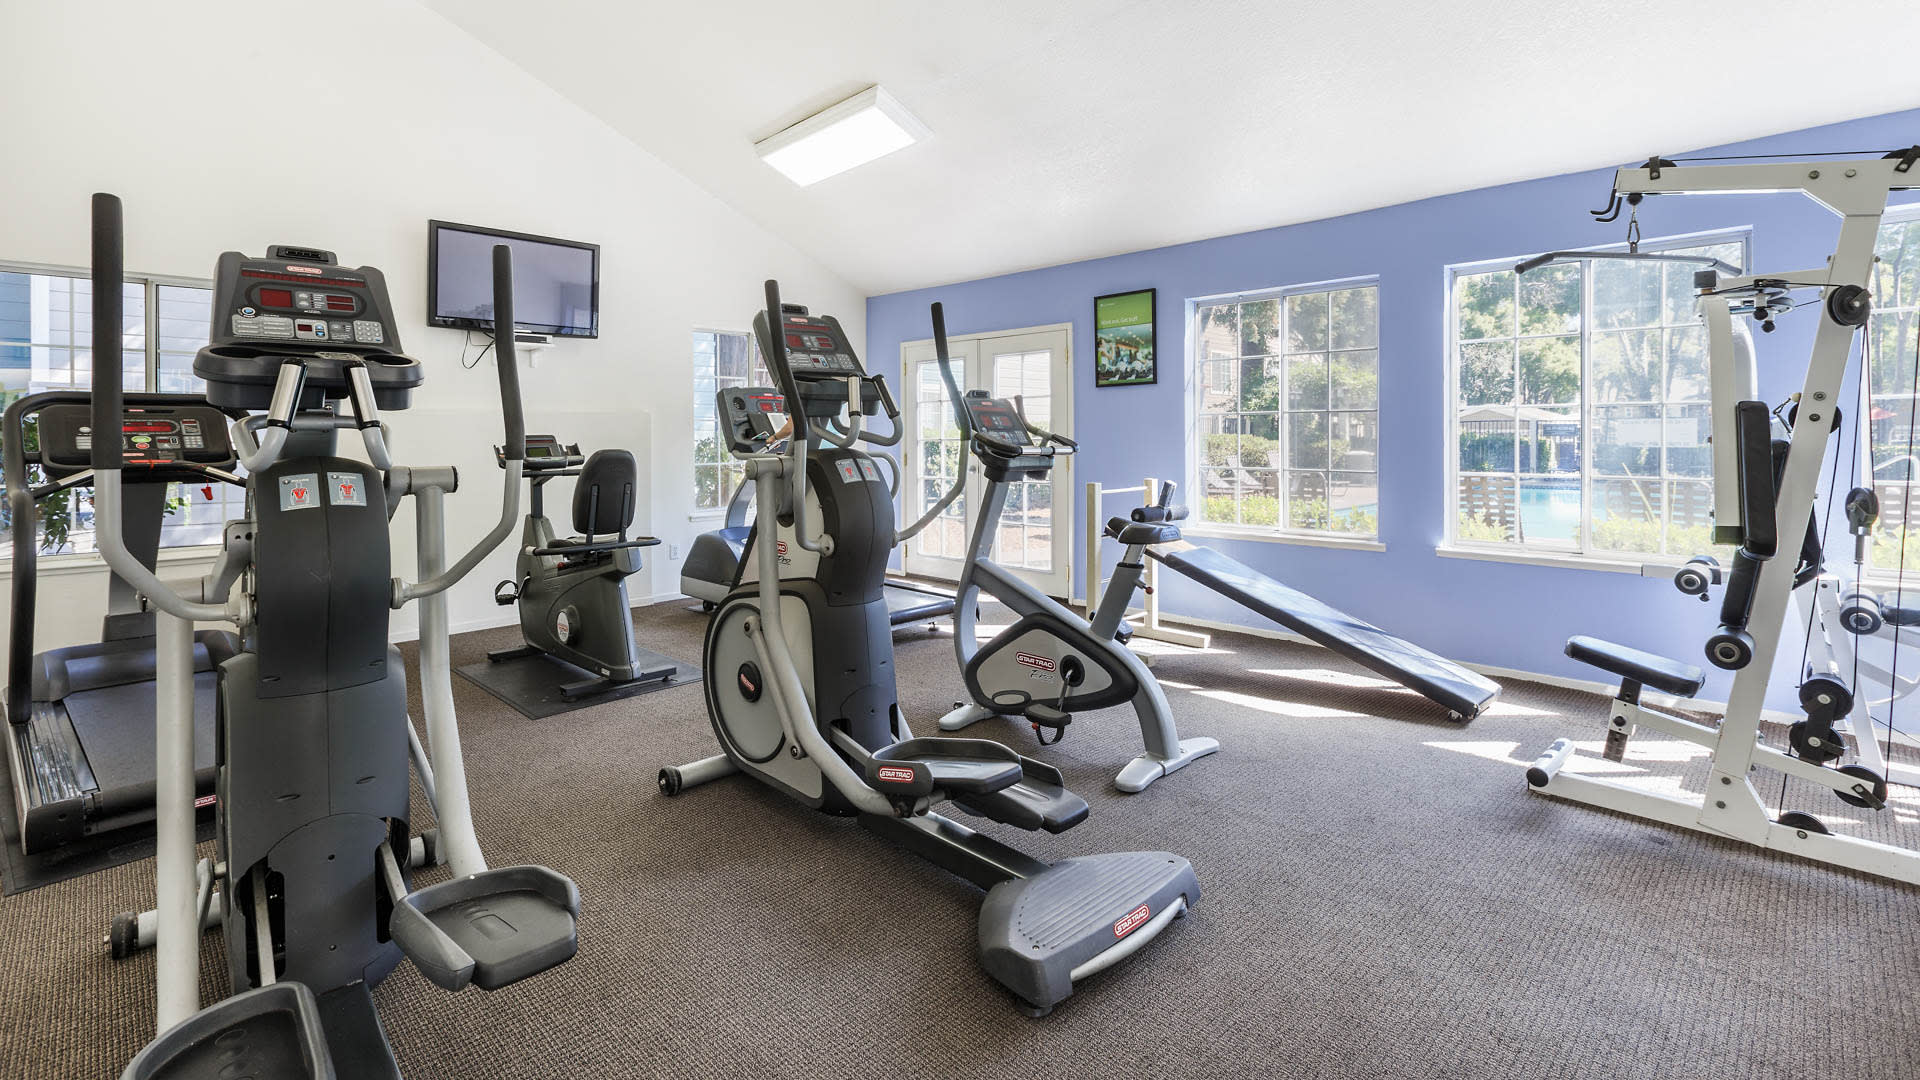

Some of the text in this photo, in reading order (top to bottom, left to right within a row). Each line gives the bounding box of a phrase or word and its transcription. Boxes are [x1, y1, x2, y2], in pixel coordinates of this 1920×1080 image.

[1018, 655, 1054, 668] STAR TRAC
[1116, 908, 1147, 932] STAR TRAC
